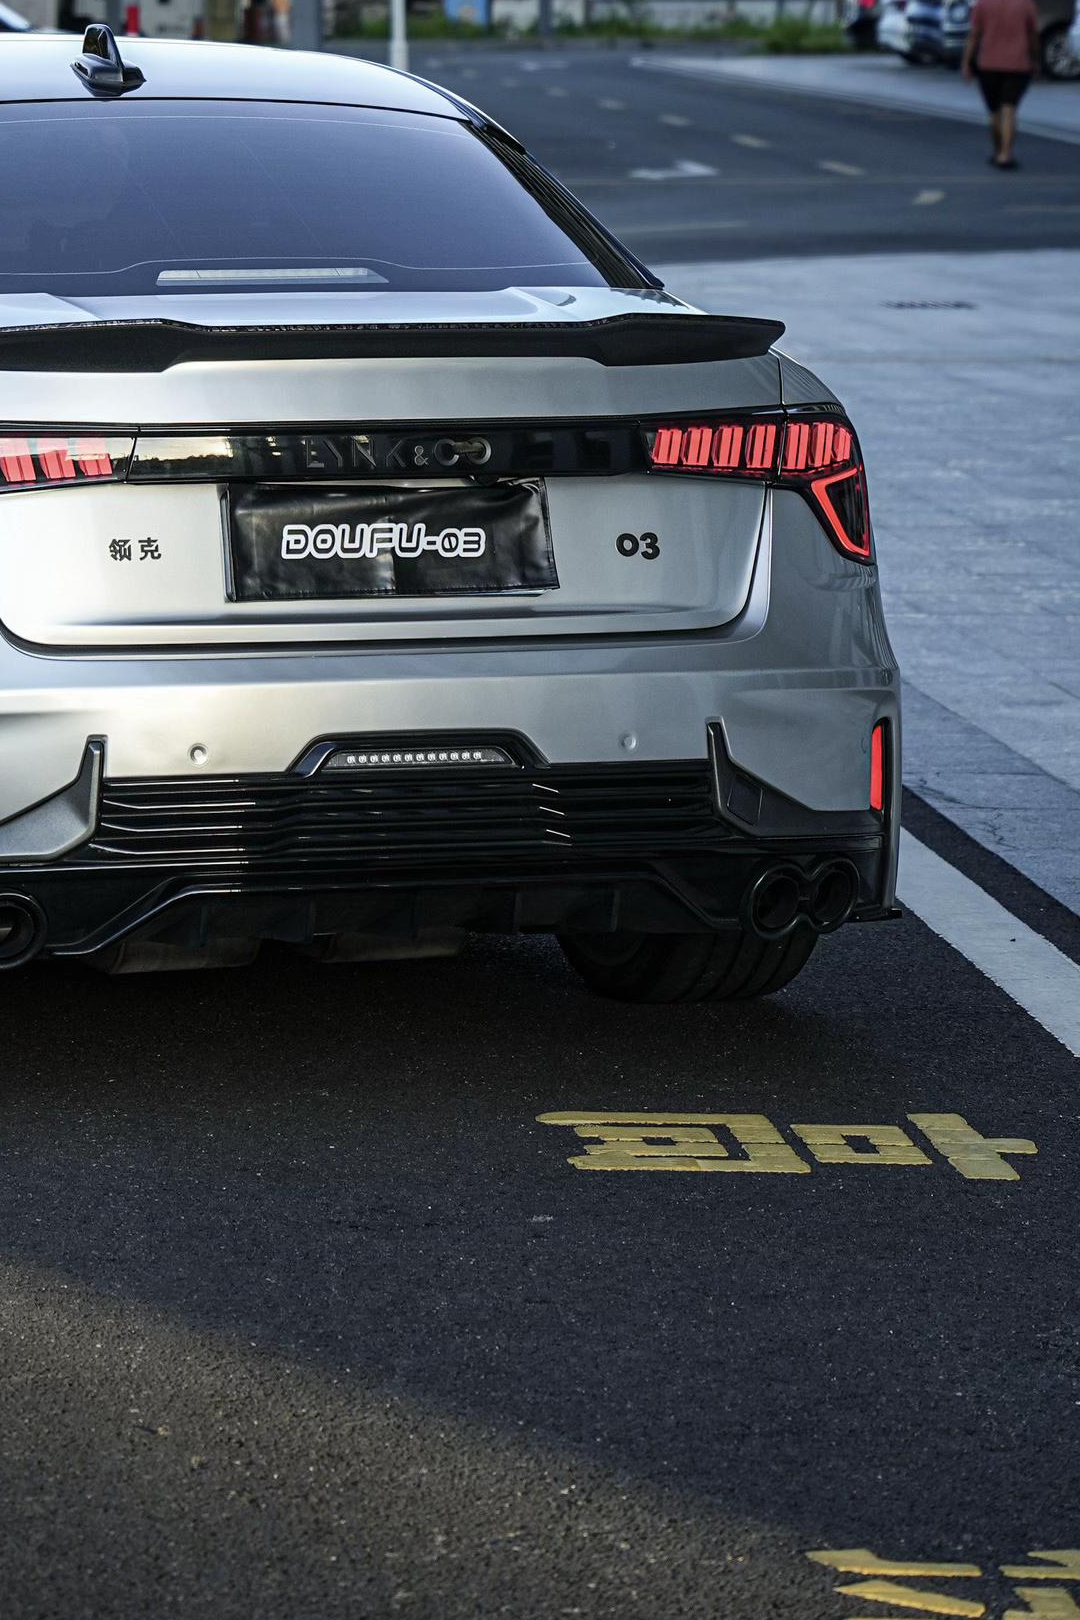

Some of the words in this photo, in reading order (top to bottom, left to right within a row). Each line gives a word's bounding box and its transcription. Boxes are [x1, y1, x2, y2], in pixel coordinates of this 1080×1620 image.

[108, 536, 162, 562] 领克
[281, 523, 486, 560] DOUFU-03
[615, 531, 661, 560] 03
